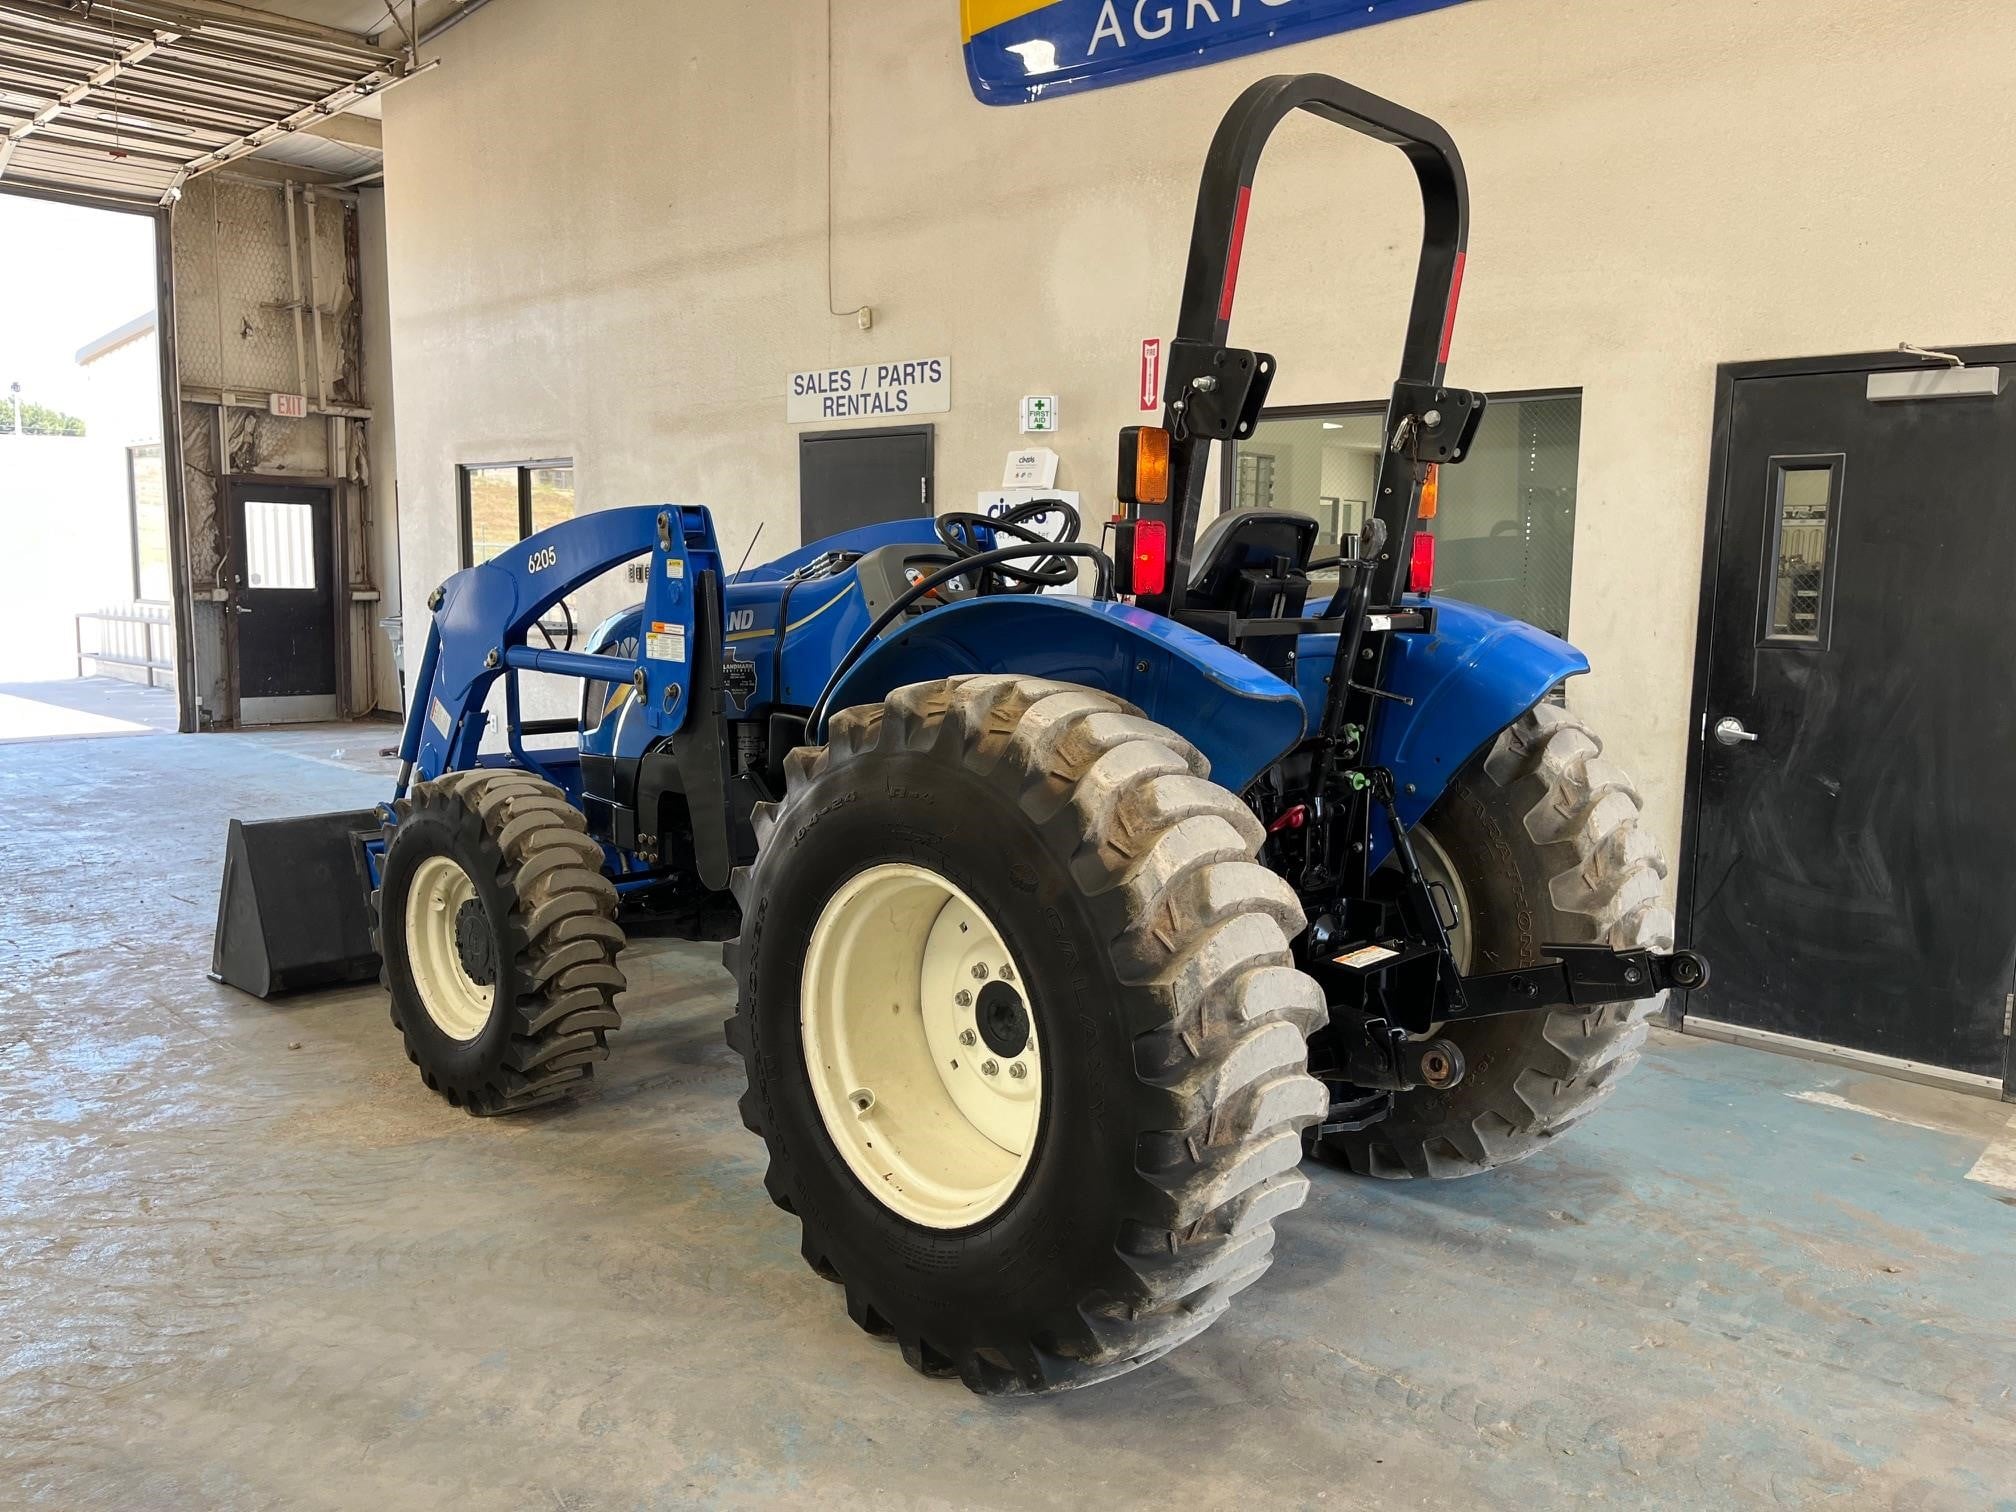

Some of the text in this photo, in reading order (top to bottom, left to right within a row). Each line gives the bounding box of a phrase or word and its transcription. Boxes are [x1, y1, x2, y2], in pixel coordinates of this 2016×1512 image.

[793, 359, 942, 396] SALES / PARTS
[277, 395, 303, 416] EXIT
[823, 389, 909, 417] RENTALS
[528, 546, 557, 575] 6205
